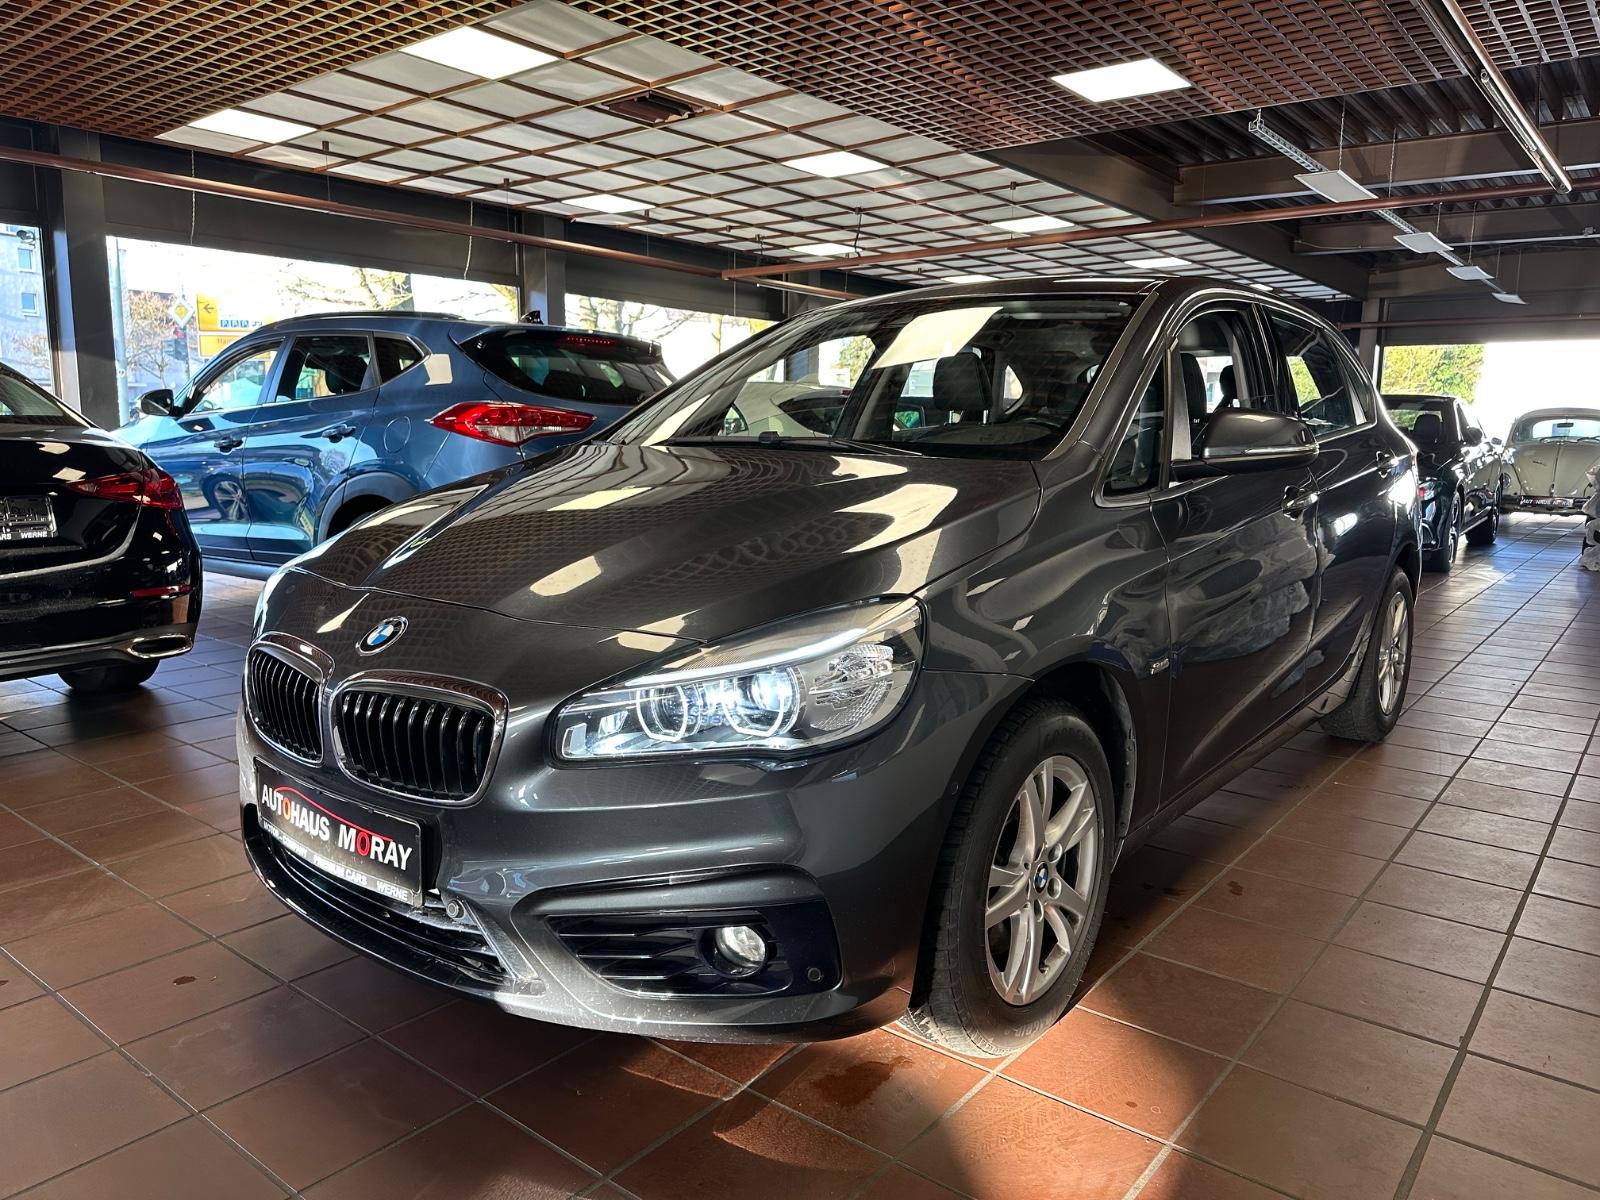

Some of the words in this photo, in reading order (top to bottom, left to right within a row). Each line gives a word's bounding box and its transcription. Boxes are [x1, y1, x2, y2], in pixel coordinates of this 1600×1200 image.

[261, 784, 331, 842] AUTOHAUS
[337, 824, 412, 871] MORAY
[376, 880, 408, 901] WERNE
